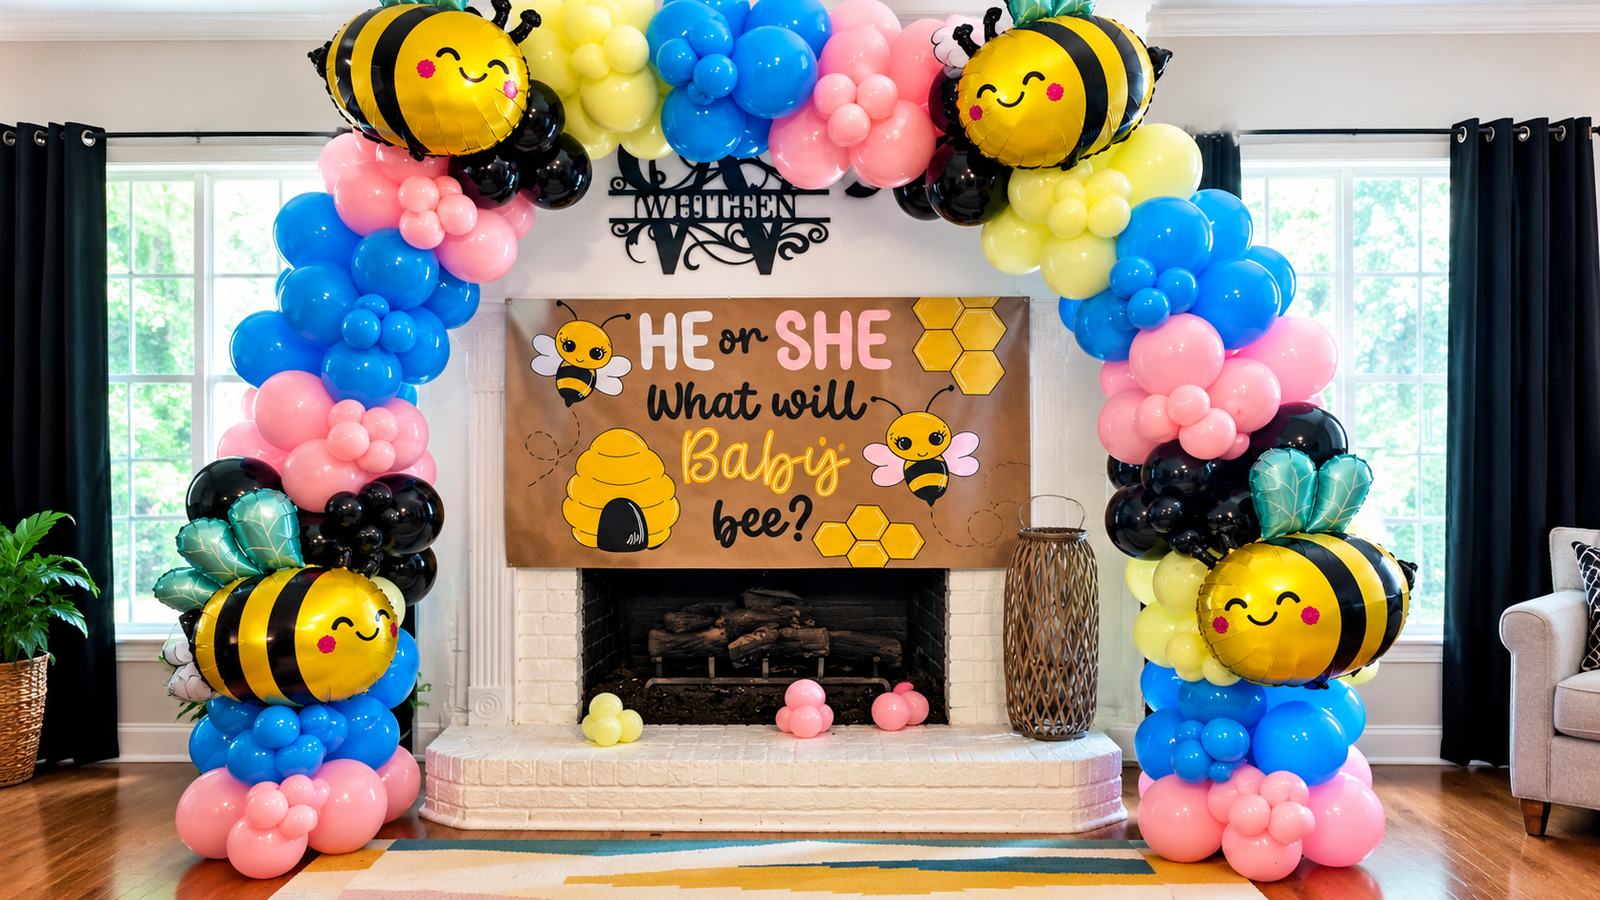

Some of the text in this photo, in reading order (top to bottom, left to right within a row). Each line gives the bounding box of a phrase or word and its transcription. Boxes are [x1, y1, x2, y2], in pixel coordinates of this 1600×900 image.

[639, 309, 892, 371] HE or SHE
[647, 379, 868, 421] What will
[681, 427, 851, 497] Baby
[712, 494, 813, 549] bee?
